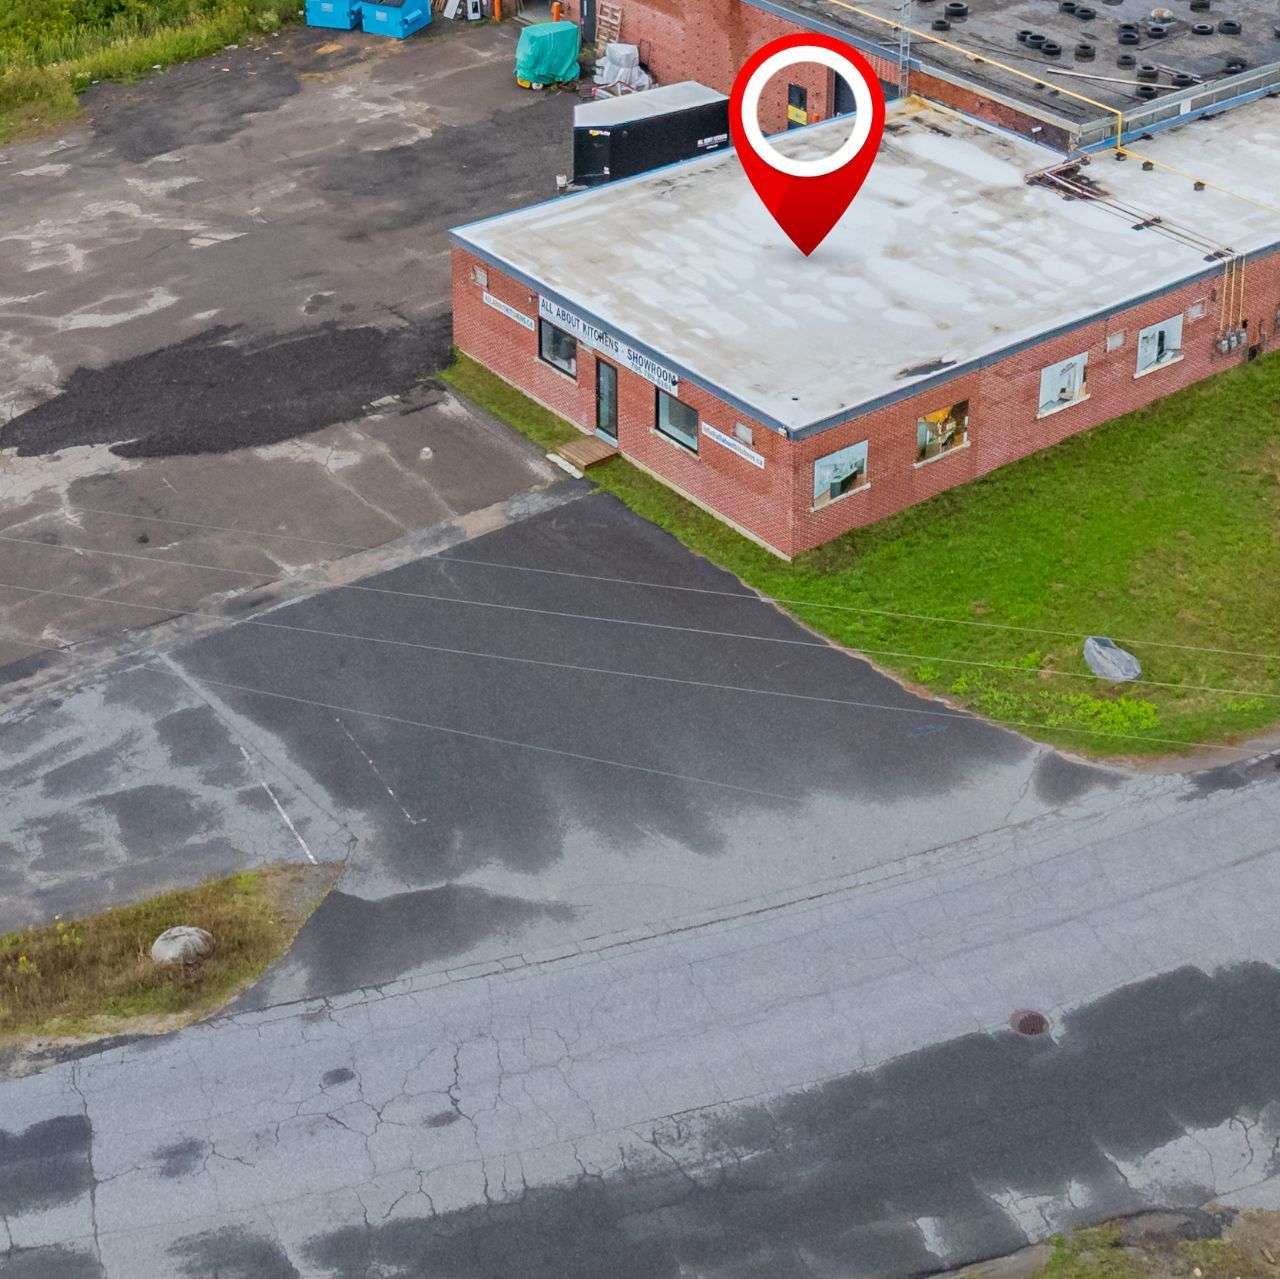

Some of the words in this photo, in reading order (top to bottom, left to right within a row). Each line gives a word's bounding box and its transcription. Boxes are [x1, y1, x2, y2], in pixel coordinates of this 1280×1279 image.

[541, 298, 554, 315] ALL
[556, 307, 581, 330] ABOUT
[582, 323, 620, 353] KITCHENS
[626, 348, 677, 386] SHOWROOM
